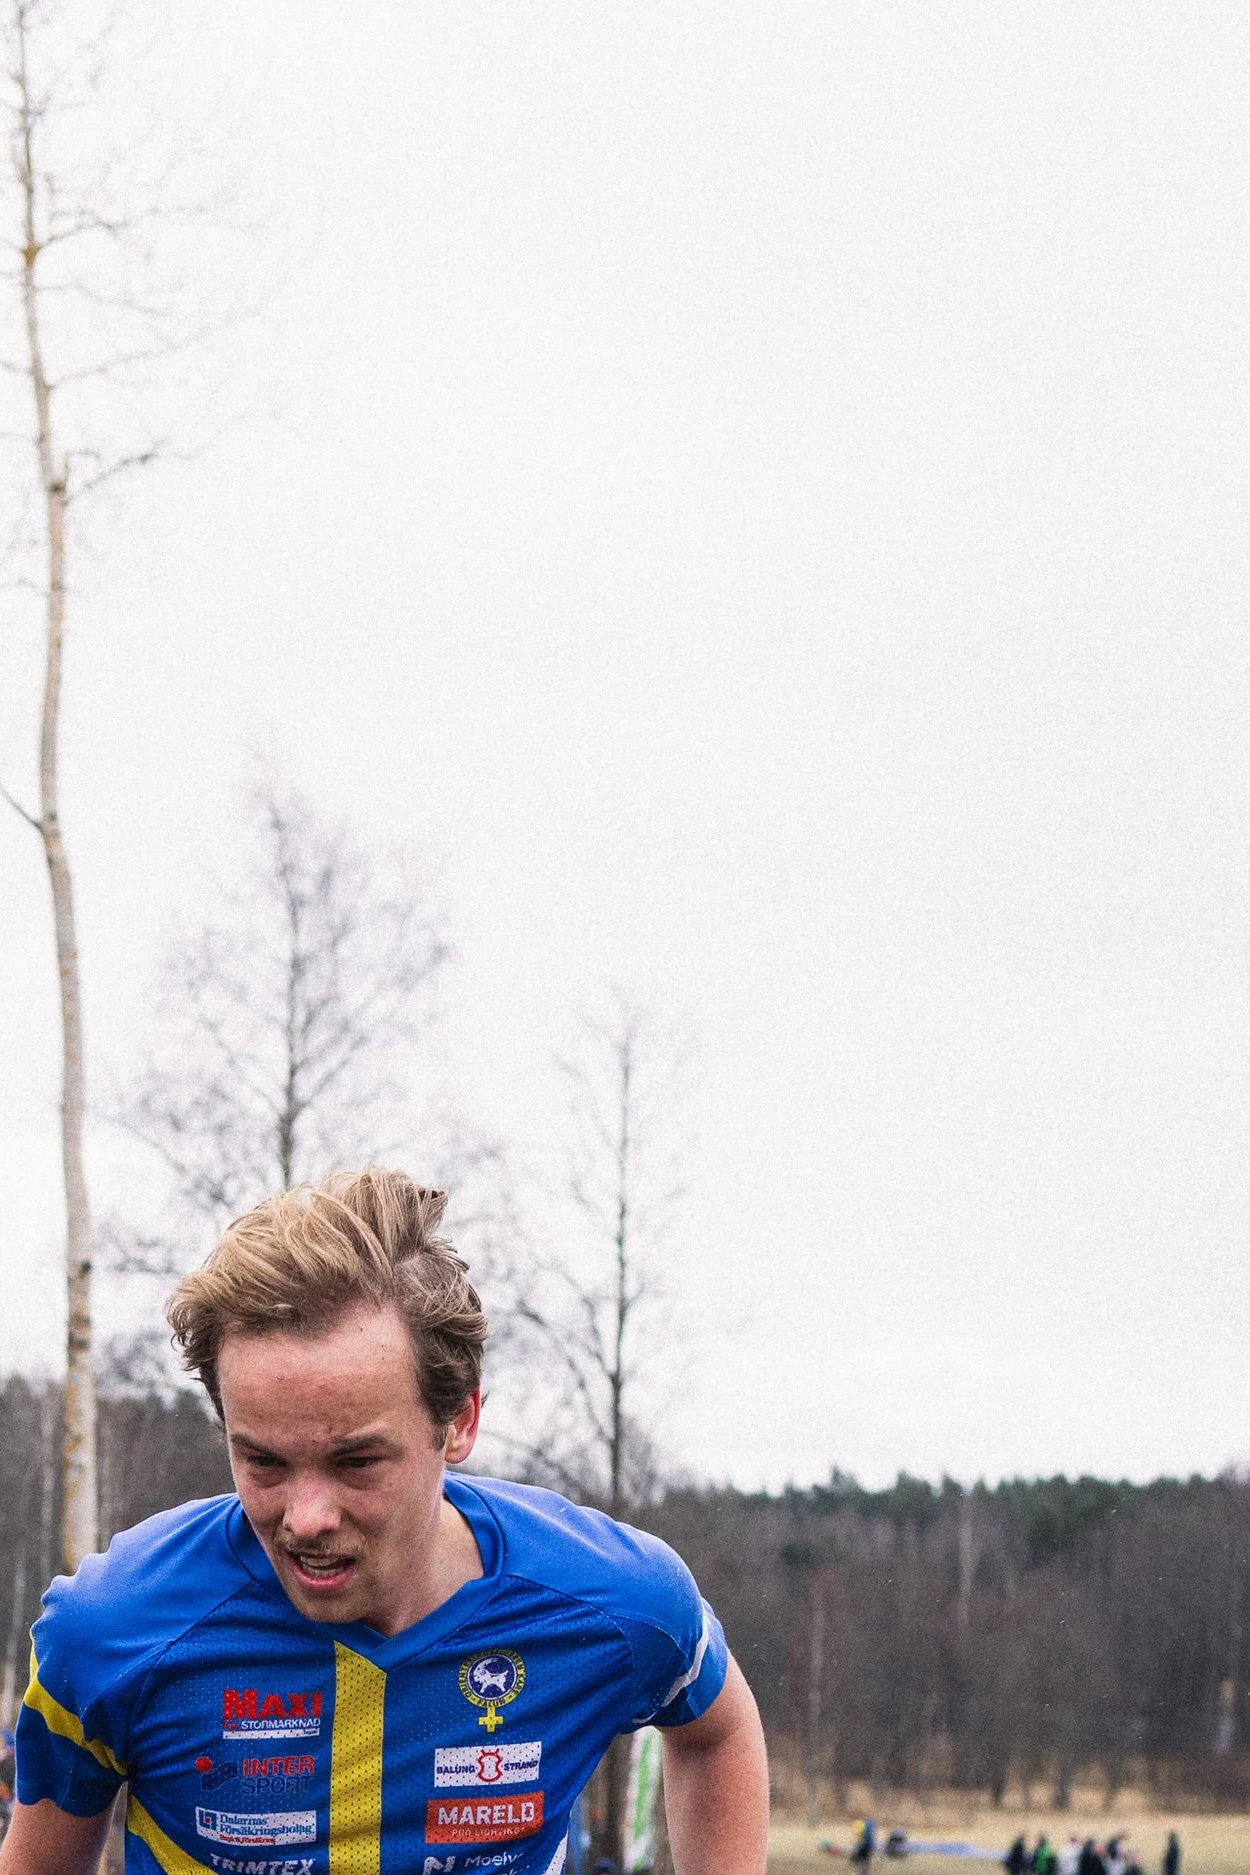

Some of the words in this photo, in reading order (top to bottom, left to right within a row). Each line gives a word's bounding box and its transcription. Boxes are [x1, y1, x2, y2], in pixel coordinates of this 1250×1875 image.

[222, 1689, 322, 1720] MAXI
[241, 1718, 321, 1730] STORMARKNAD
[242, 1755, 315, 1776] INTER
[437, 1765, 476, 1775] BALUNG
[503, 1760, 539, 1772] STRAND
[241, 1775, 314, 1795] SPORT
[220, 1813, 268, 1826] Dalarnas
[437, 1801, 535, 1825] MARELD
[210, 1853, 314, 1875] TRIMTEX
